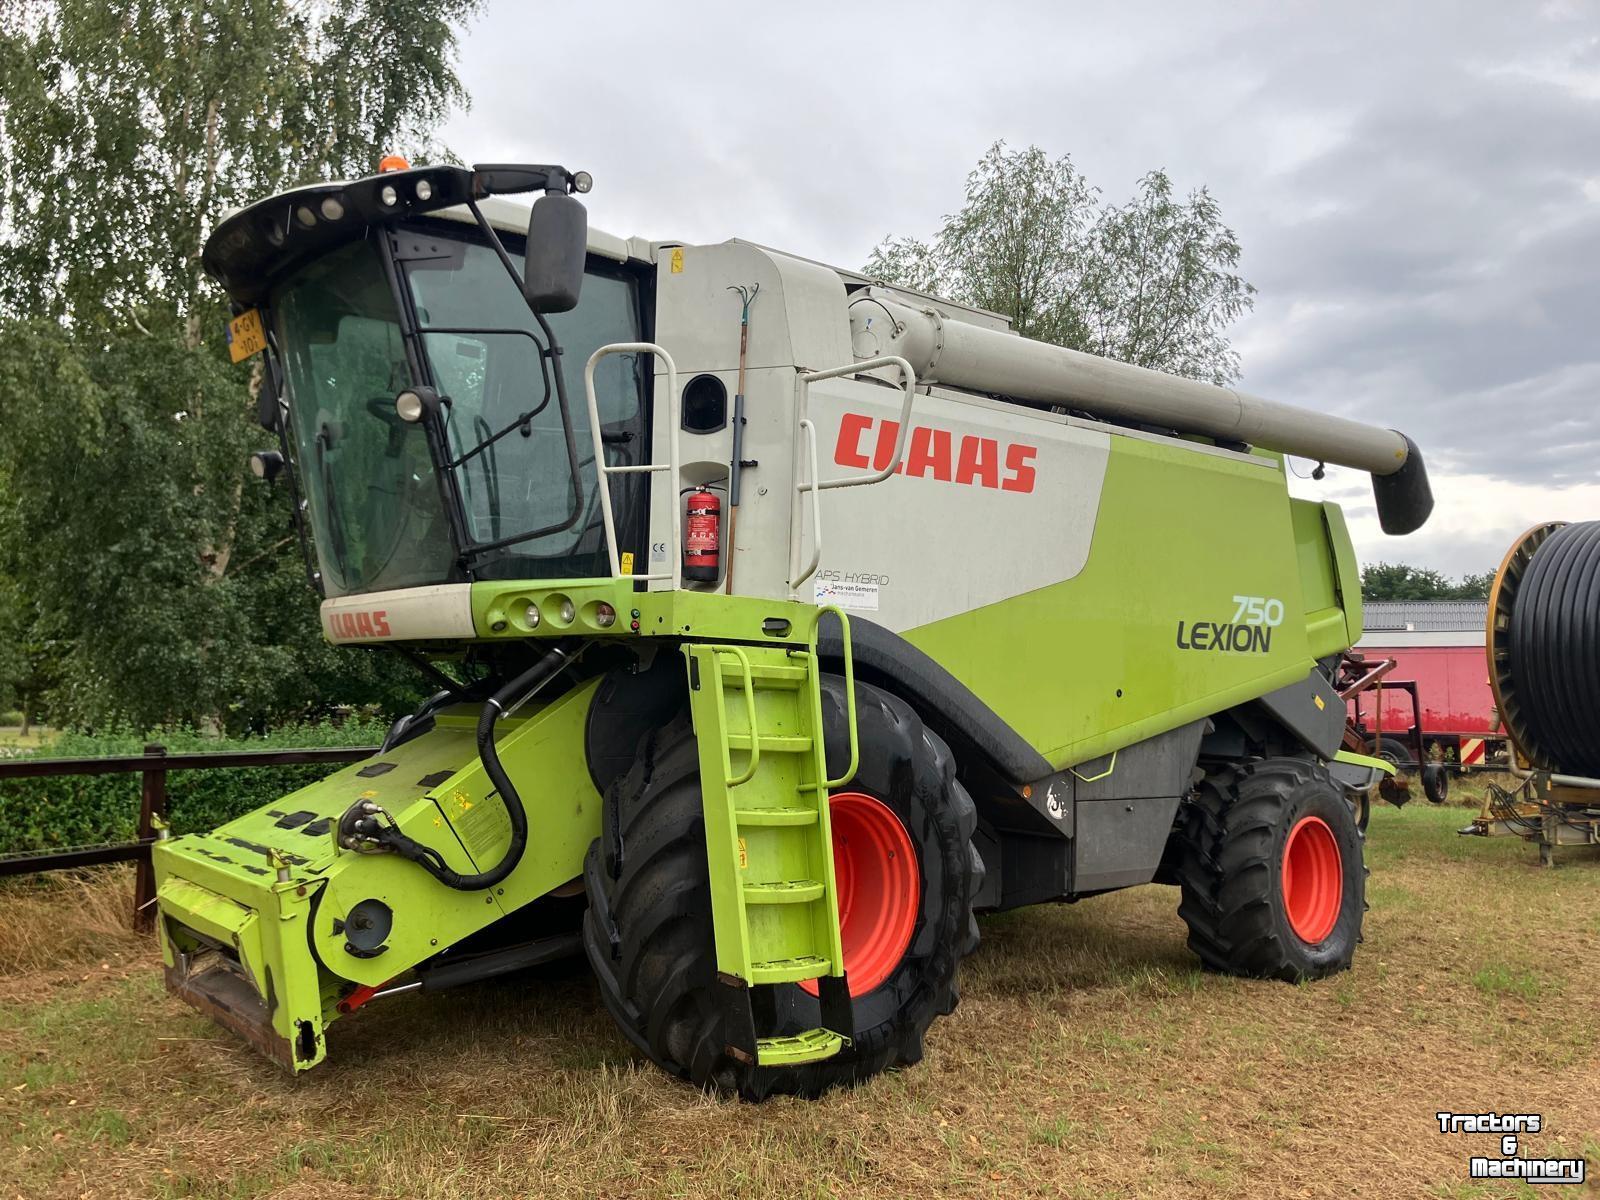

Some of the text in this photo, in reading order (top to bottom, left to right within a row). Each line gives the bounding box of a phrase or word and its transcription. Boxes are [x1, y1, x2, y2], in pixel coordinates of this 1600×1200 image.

[834, 412, 1038, 494] CLAAS
[815, 569, 890, 586] APS HYBRID
[329, 610, 391, 639] CLAAS
[1231, 595, 1285, 627] 750
[1176, 620, 1272, 653] LEXION
